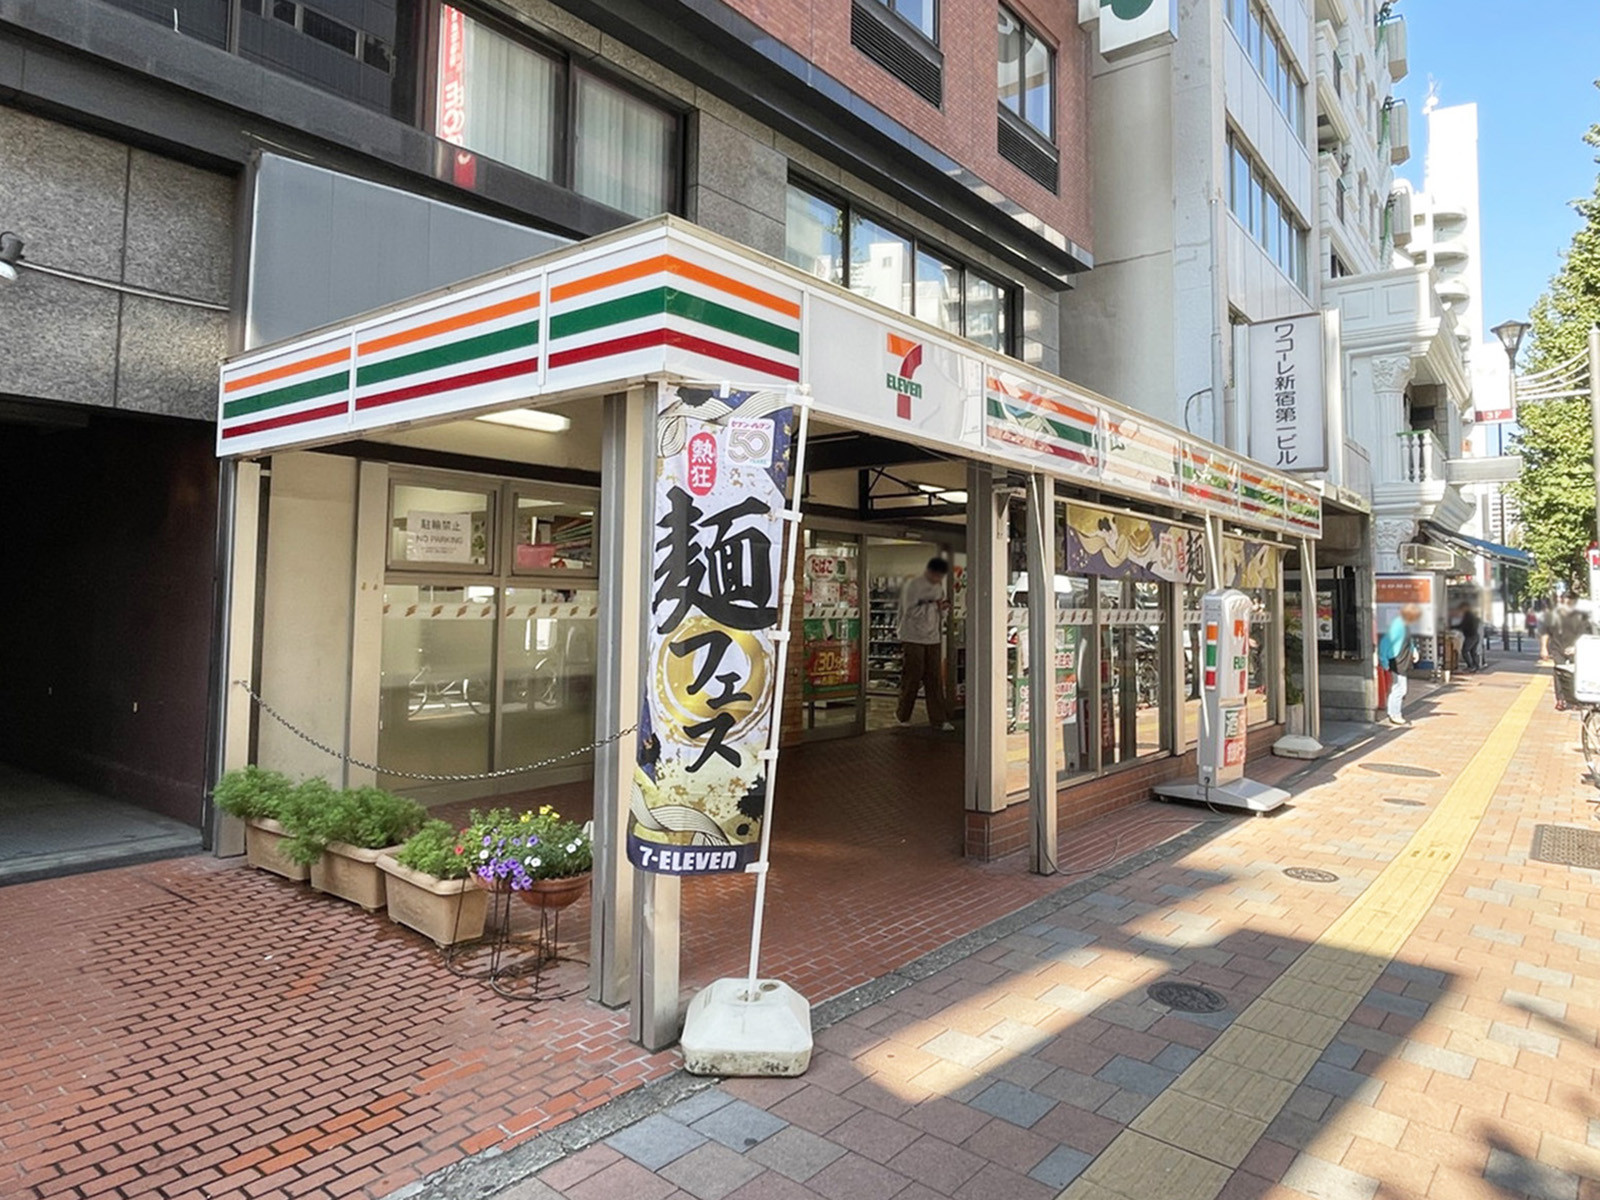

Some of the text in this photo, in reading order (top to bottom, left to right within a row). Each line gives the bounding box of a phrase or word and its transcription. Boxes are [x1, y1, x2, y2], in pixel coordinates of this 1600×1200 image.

[1275, 323, 1297, 465] ワコーレ新宿第一ビル
[690, 438, 717, 488] 熱狂
[728, 429, 771, 463] 50
[651, 485, 778, 773] 麺フェス
